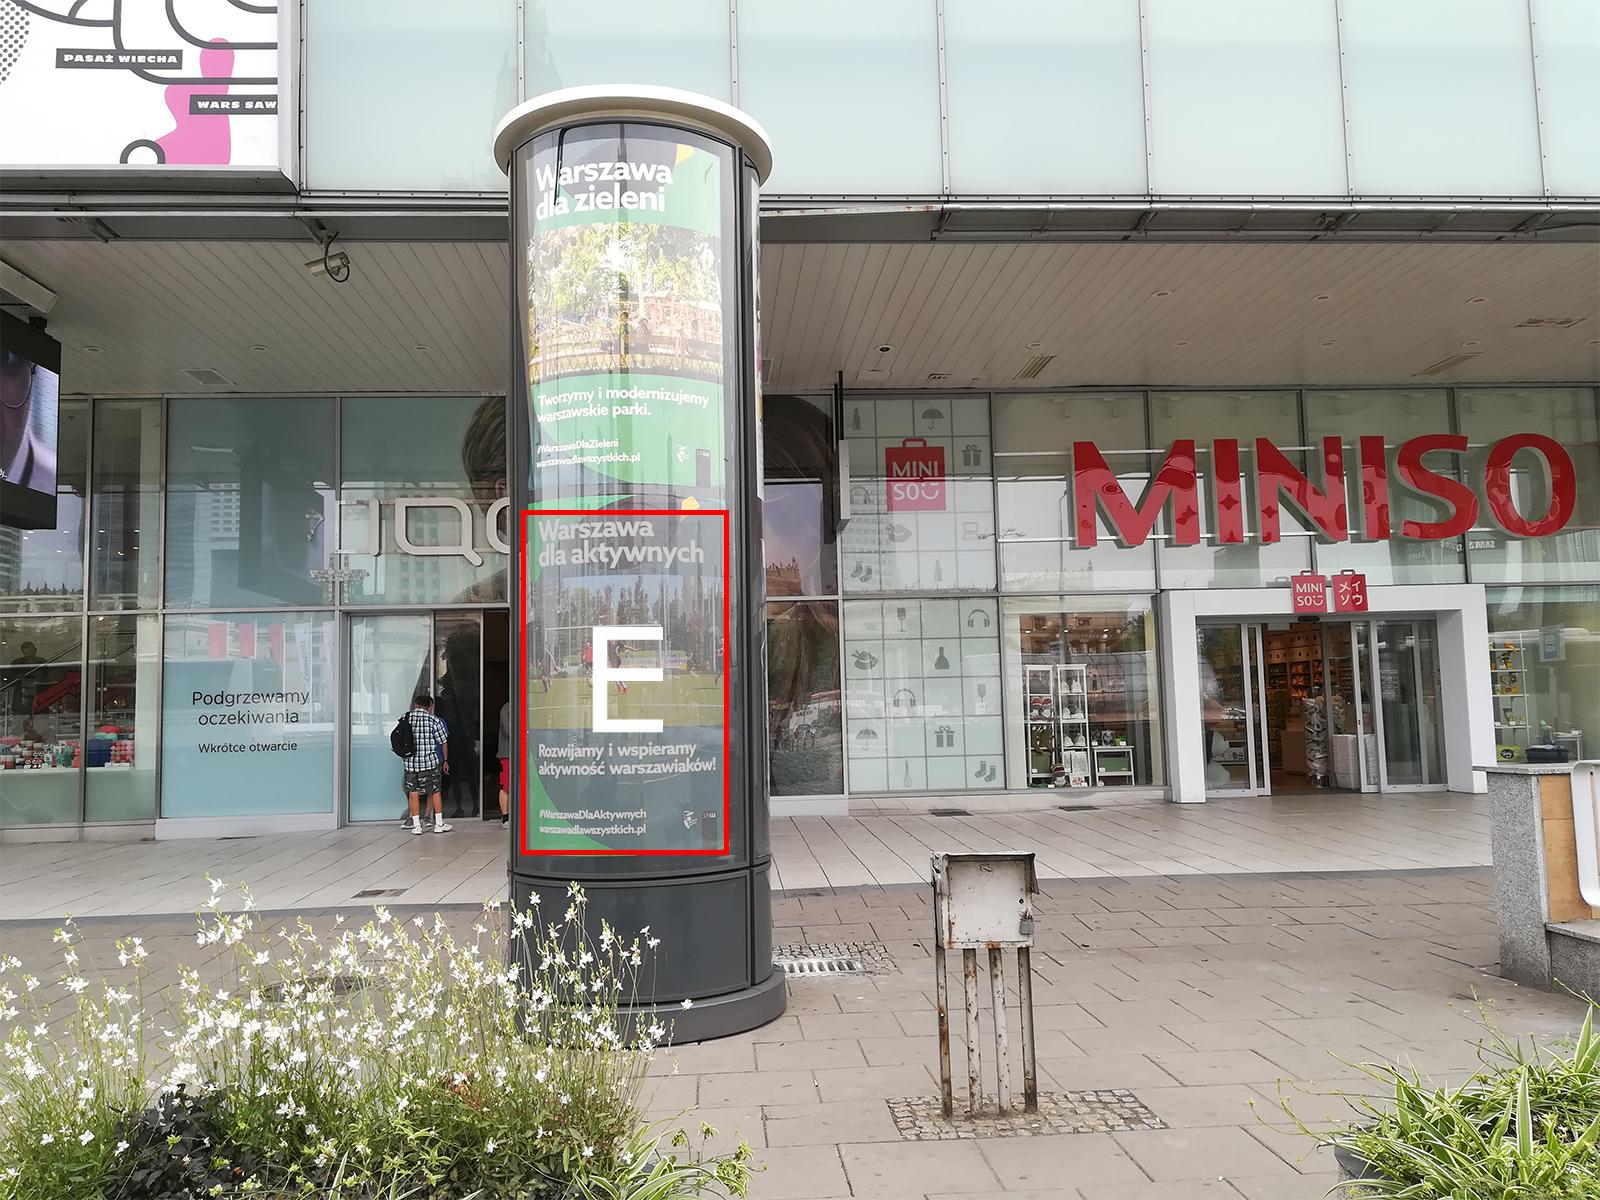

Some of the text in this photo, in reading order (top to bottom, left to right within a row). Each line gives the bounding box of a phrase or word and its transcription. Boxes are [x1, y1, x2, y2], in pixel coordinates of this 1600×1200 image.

[63, 53, 178, 64] PASAŻ WIECHA
[197, 100, 278, 109] WARS SAW
[535, 160, 674, 192] Warszawa
[536, 182, 666, 220] dla zieleni
[538, 388, 595, 408] Tworzymy
[606, 386, 710, 409] modernizujemy
[536, 402, 652, 424] warszawskie parki.
[892, 460, 939, 478] MINI
[1071, 432, 1577, 548] MINISO
[538, 518, 655, 543] Warszawa
[538, 540, 705, 570] dla aktywnych
[1296, 582, 1323, 594] MINI
[192, 690, 310, 708] Podgrzewamy
[198, 710, 299, 726] oczekiwania
[198, 741, 298, 754] Wkrótce otwarcie
[538, 742, 604, 760] Rozwijamy
[617, 742, 697, 760] wspieramy
[538, 757, 717, 779] aktywność warszawiaków!
[538, 808, 647, 820] #WarszawaDlaAktywnych
[538, 824, 646, 838] warszawadlawszystkich.pl
